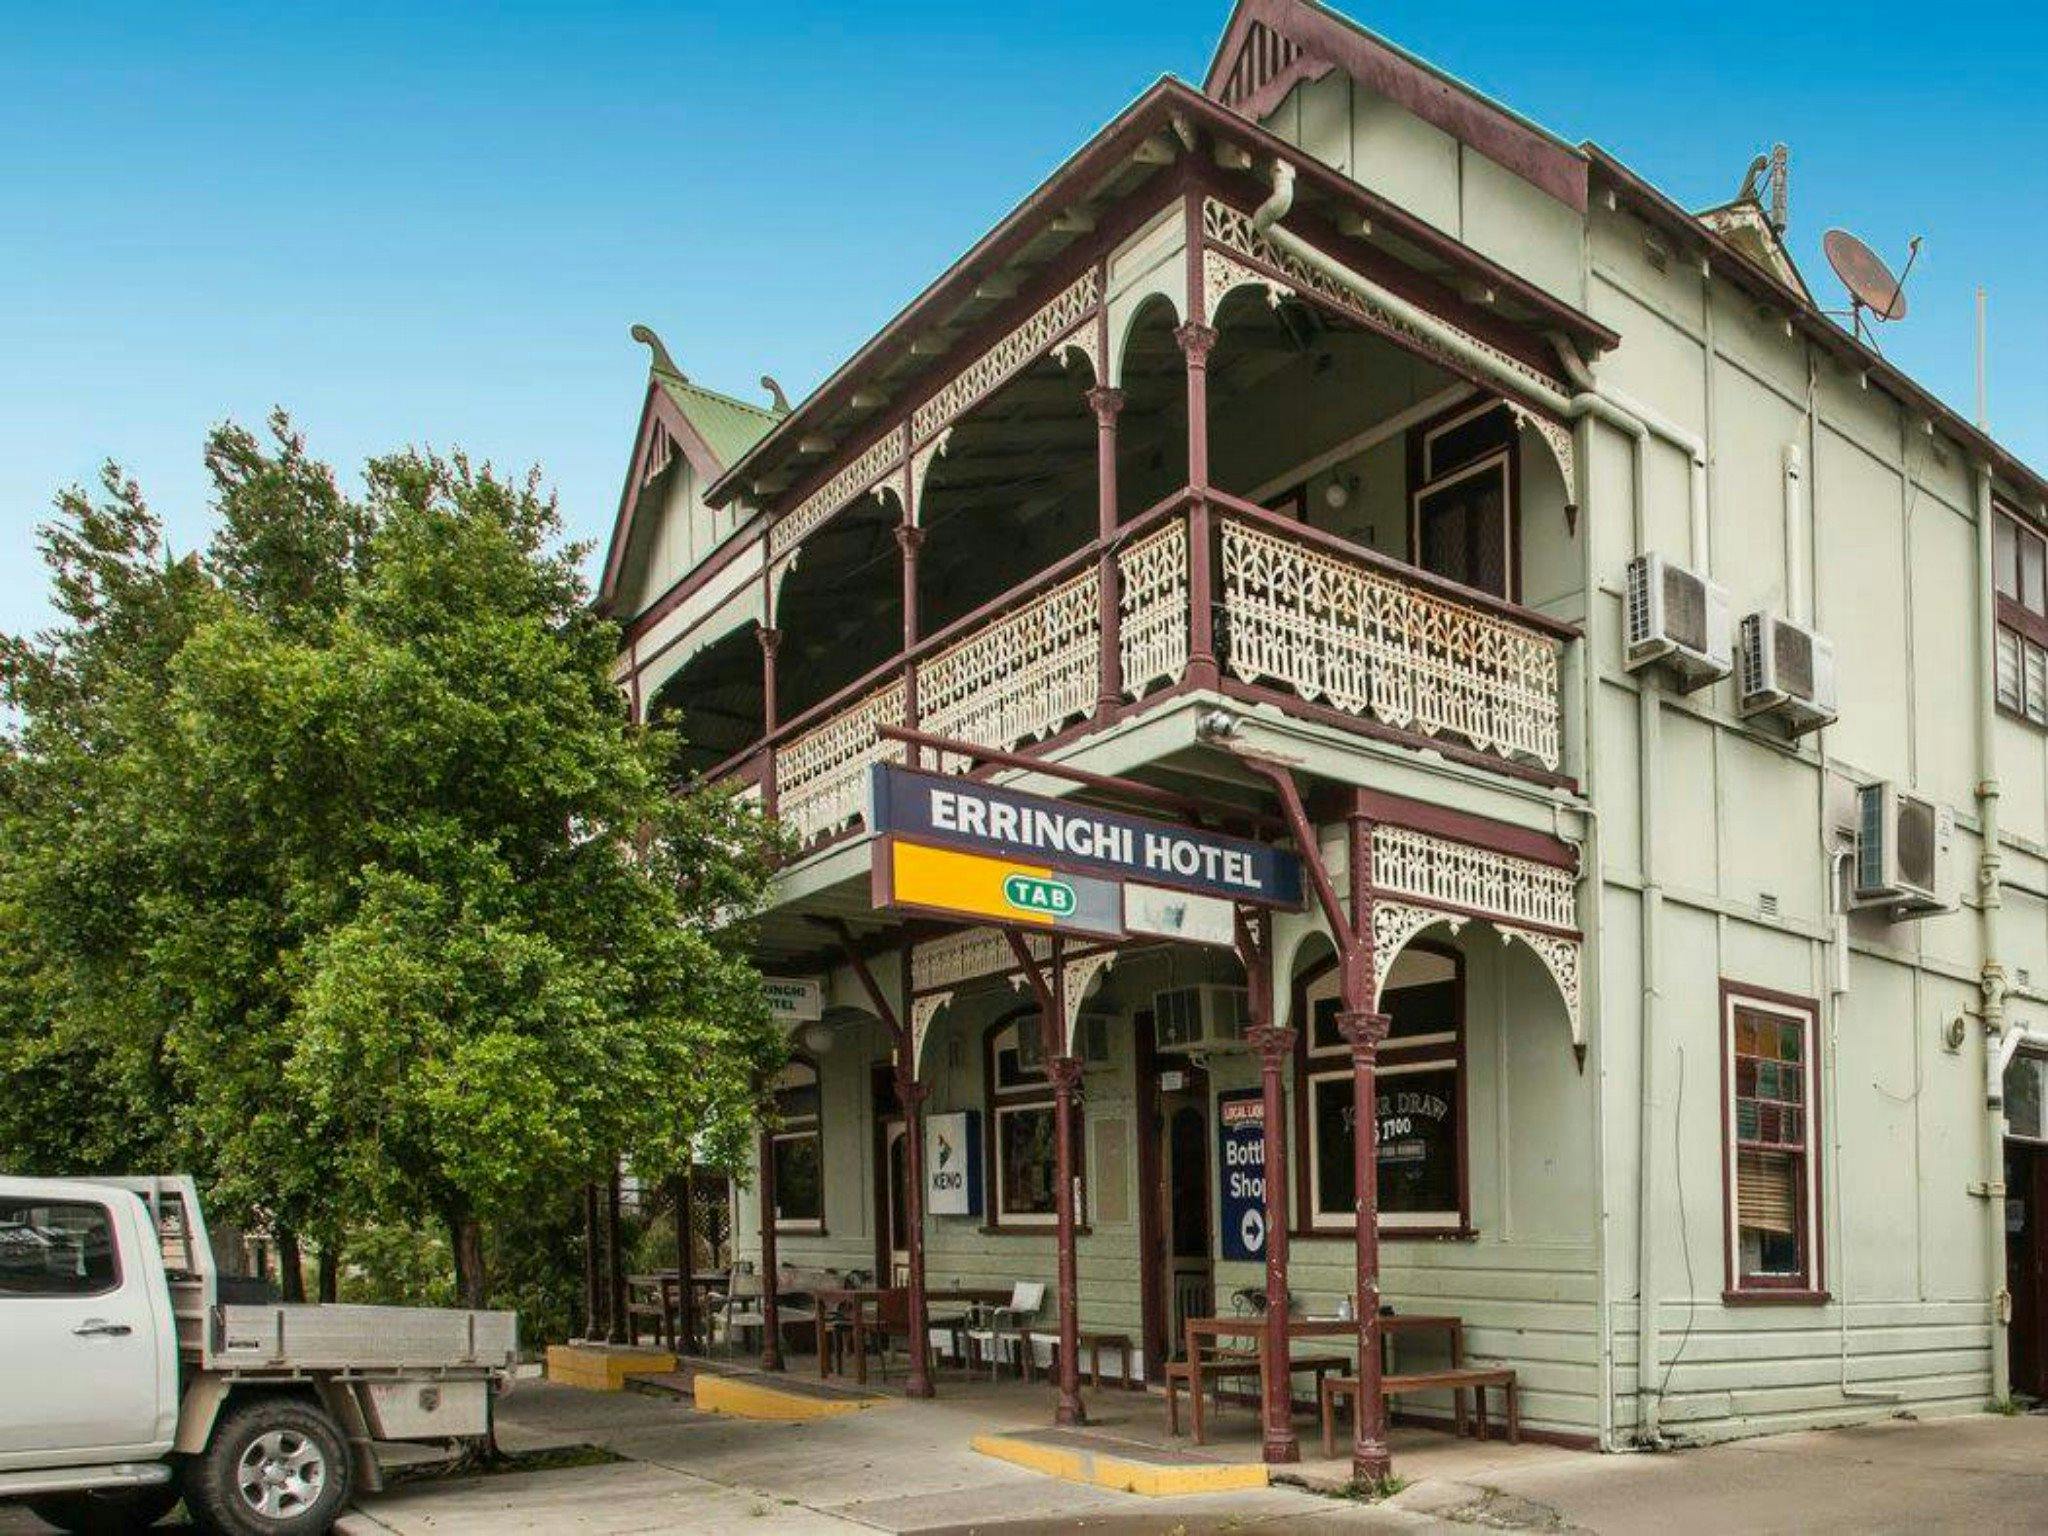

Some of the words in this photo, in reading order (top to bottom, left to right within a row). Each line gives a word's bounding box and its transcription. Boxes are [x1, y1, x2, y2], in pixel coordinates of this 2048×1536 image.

[930, 789, 1134, 865] ERRINGHI
[1145, 833, 1262, 889] HOTEL
[1016, 880, 1067, 907] TAB
[1226, 1139, 1265, 1166] Bottl
[932, 1172, 962, 1190] KENO
